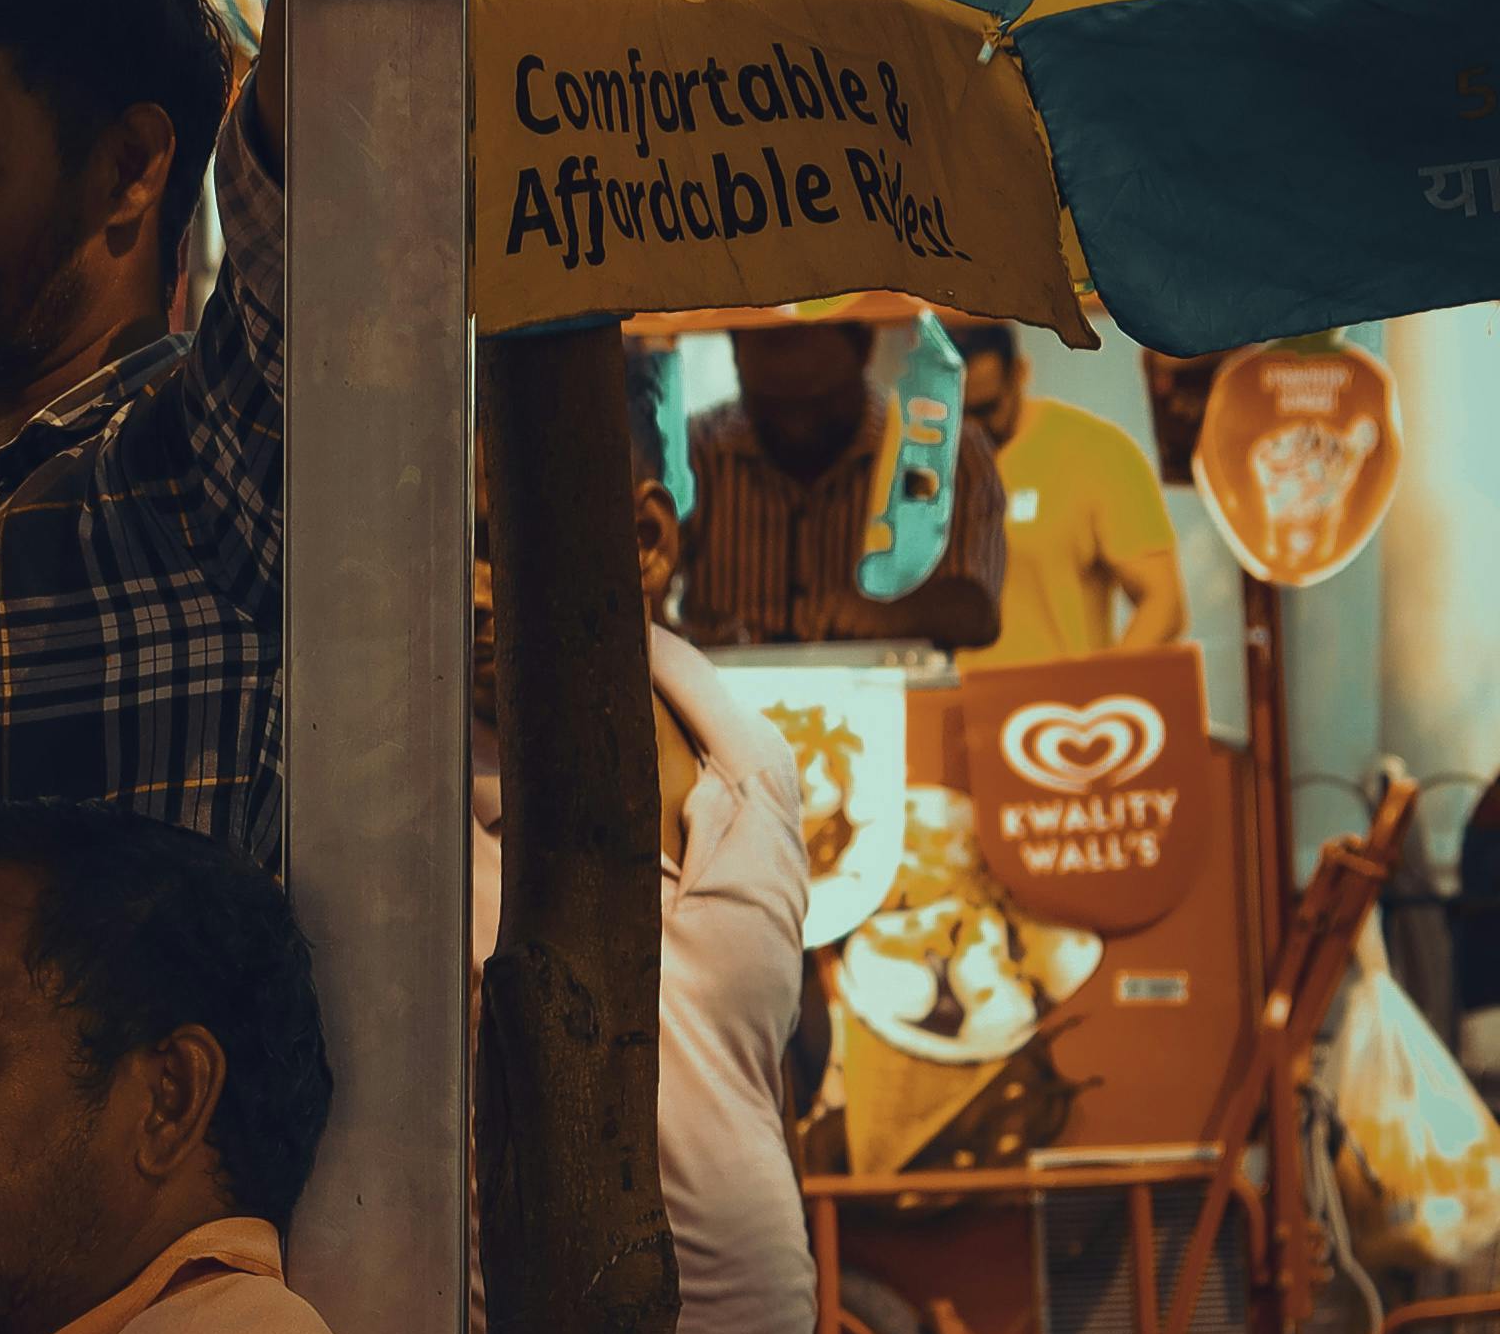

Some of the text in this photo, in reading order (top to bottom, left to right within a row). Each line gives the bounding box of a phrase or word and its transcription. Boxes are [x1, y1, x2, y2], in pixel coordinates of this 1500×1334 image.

[513, 43, 876, 159] Comfortable
[506, 146, 836, 269] Affordable
[999, 788, 1178, 840] KWALITY
[1019, 829, 1161, 875] WALL'S
